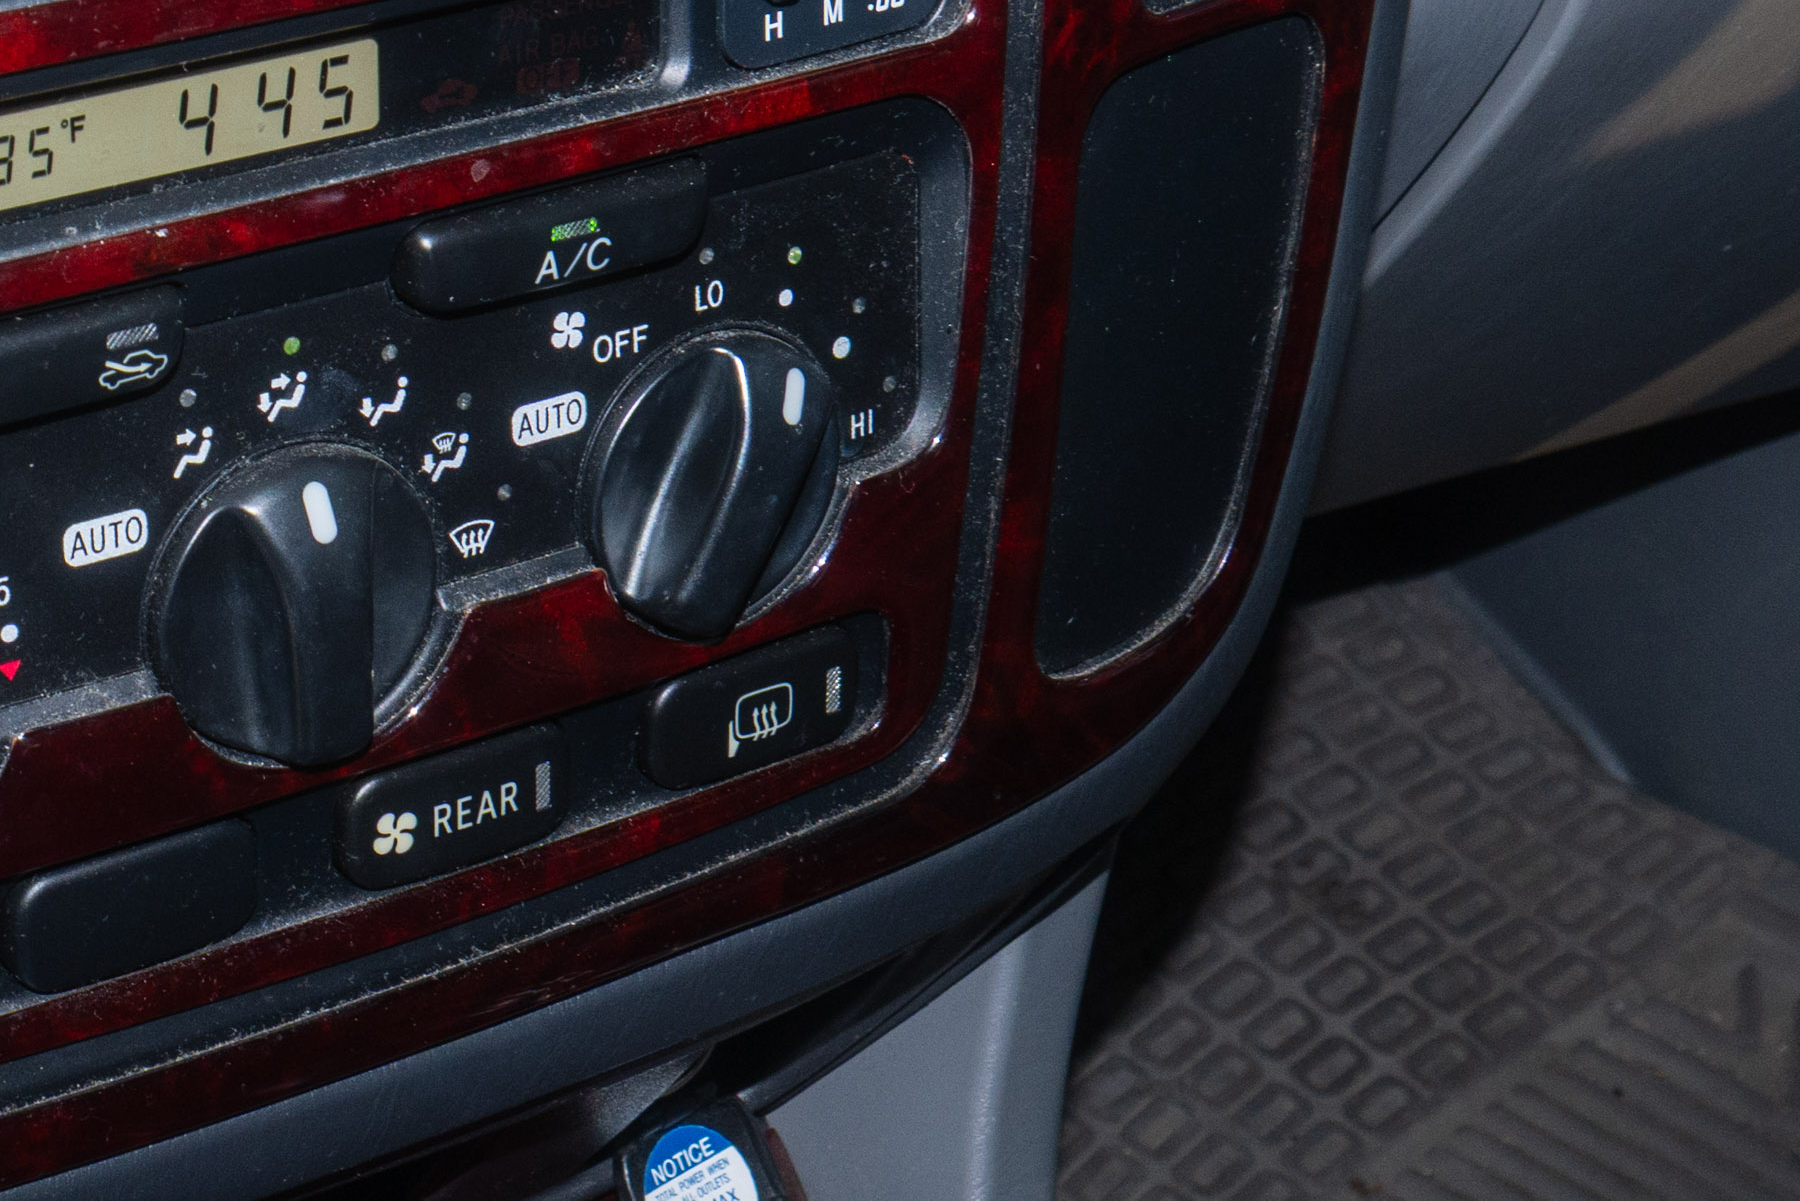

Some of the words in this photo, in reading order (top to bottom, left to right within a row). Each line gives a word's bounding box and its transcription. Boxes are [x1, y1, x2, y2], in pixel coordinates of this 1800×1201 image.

[764, 10, 784, 42] H
[535, 237, 612, 285] A/C
[694, 279, 725, 312] LO
[592, 324, 649, 363] OFF
[517, 398, 582, 440] AUTO
[850, 408, 875, 440] HI
[69, 515, 143, 560] AUTO
[433, 781, 518, 838] REAR
[650, 1136, 715, 1186] NOTICE
[678, 1170, 705, 1191] POWER
[696, 1173, 731, 1198] OUTLETS
